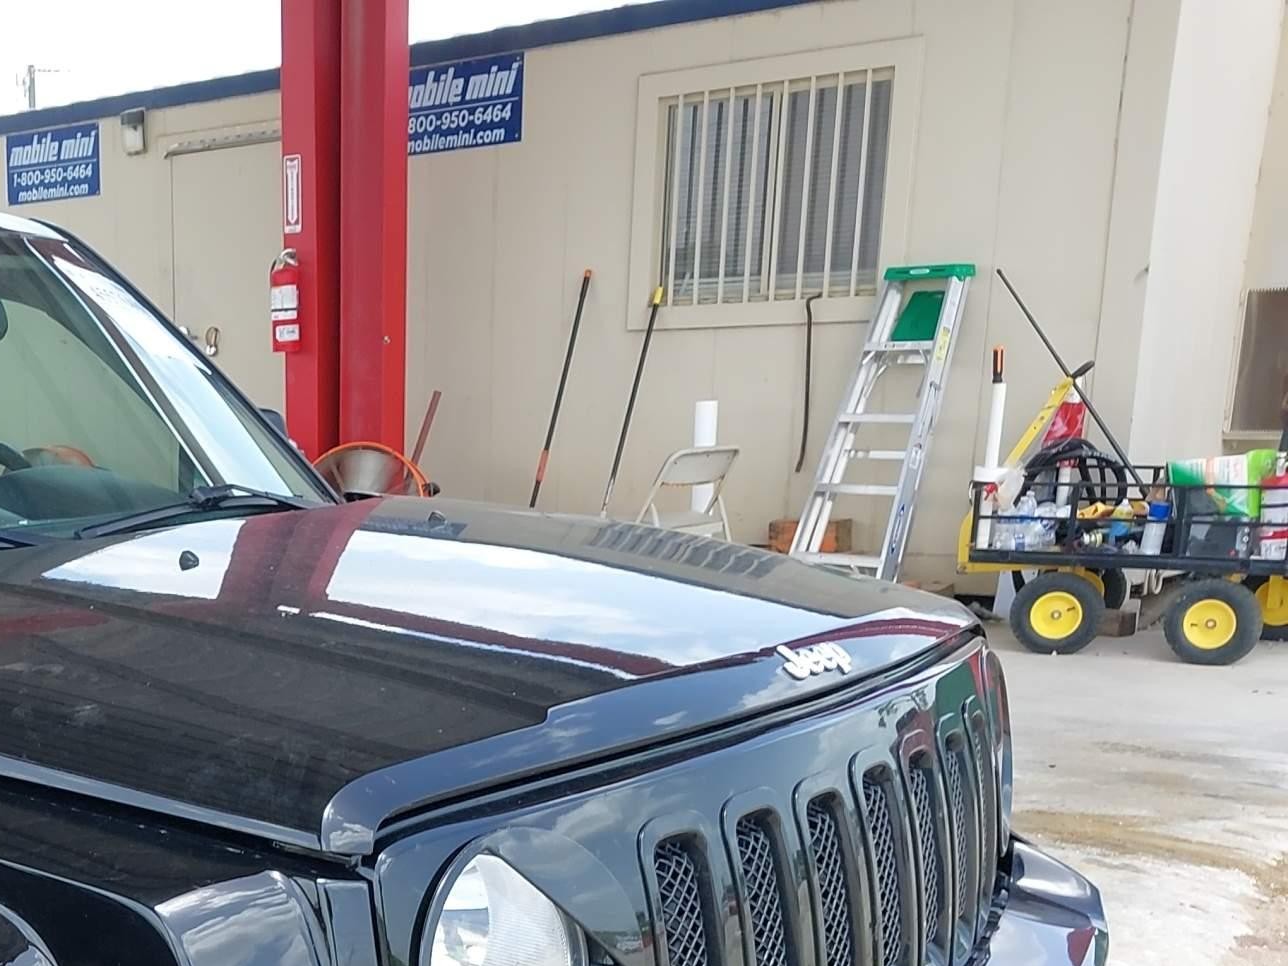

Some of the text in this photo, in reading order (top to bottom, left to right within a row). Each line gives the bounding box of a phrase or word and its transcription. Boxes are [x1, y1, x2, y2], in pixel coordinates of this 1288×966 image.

[465, 61, 520, 101] mini
[408, 102, 512, 134] 800-950-6464
[9, 129, 97, 167] mobile mini
[13, 163, 92, 188] 1-800-950-6464
[18, 182, 89, 202] mobilemini.com
[776, 642, 852, 680] Jeep
